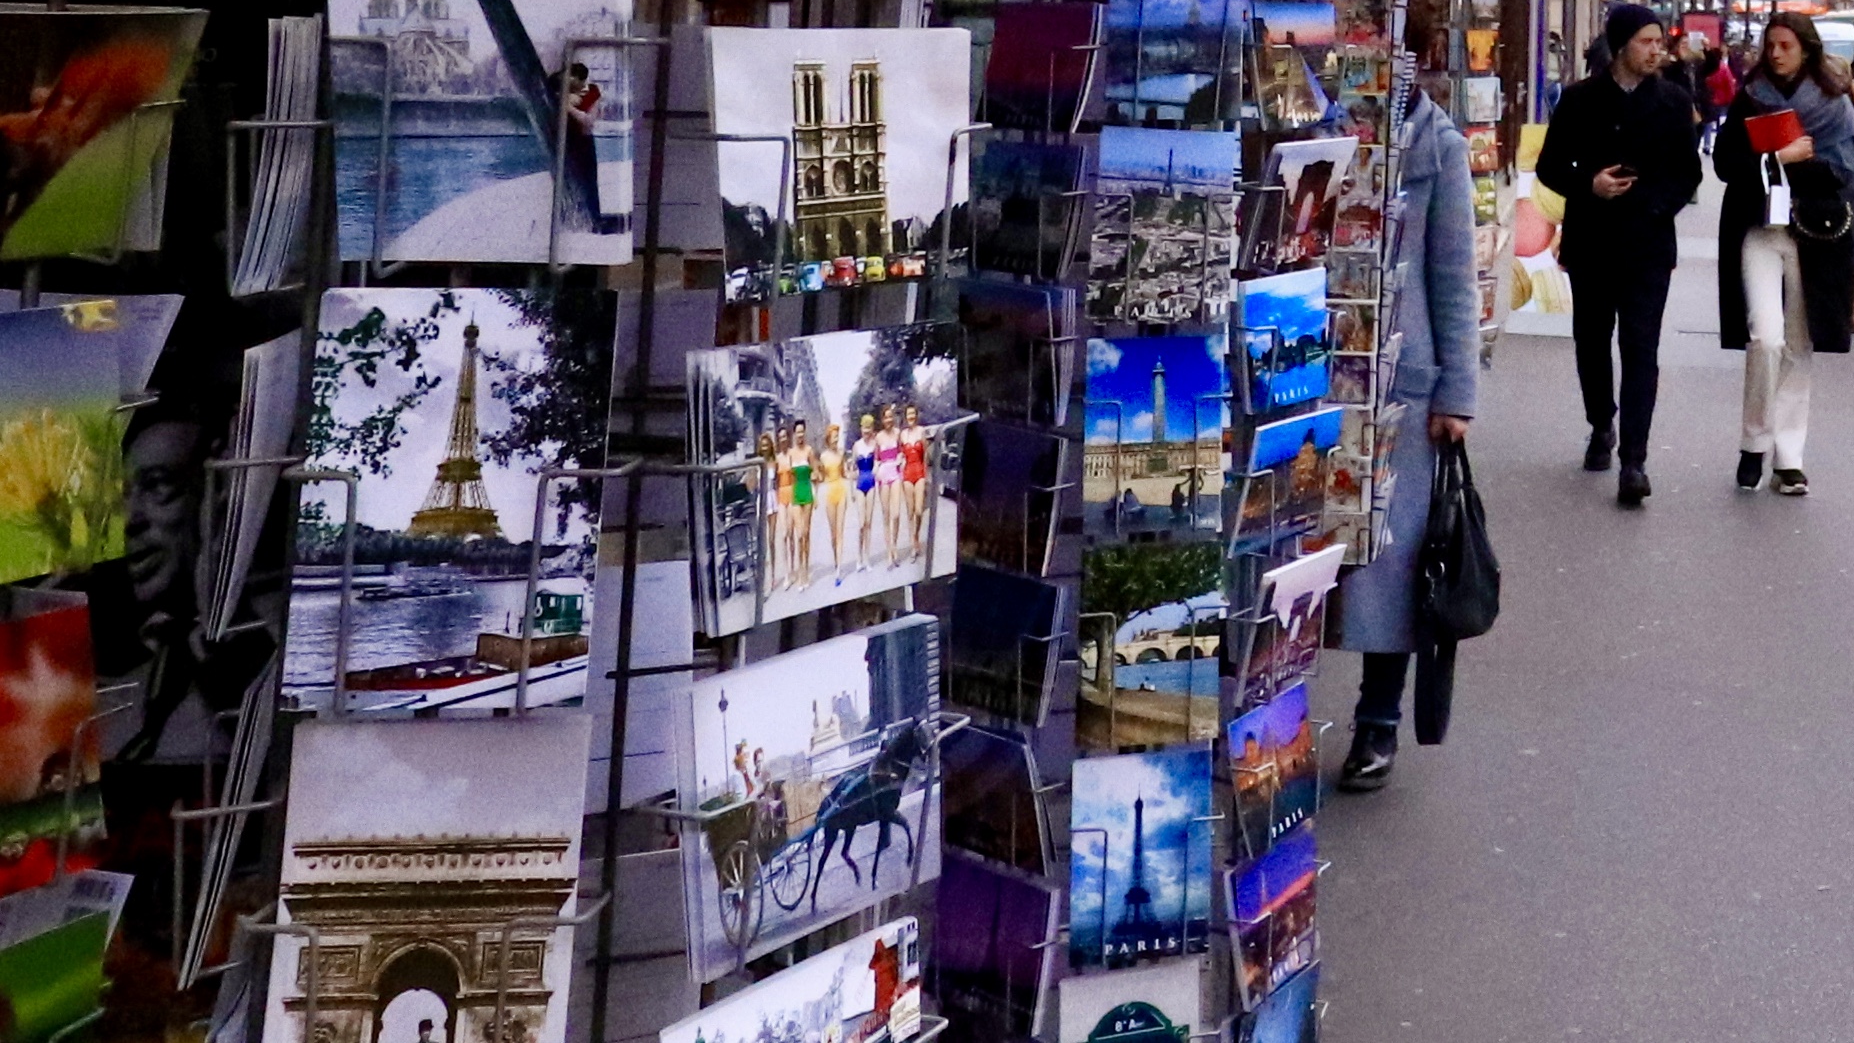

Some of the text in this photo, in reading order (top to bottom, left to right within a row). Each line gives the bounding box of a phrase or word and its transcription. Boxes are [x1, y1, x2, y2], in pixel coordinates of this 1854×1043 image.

[1274, 385, 1309, 404] PARIS
[1271, 807, 1304, 838] PARIS
[1104, 937, 1176, 956] PARIS
